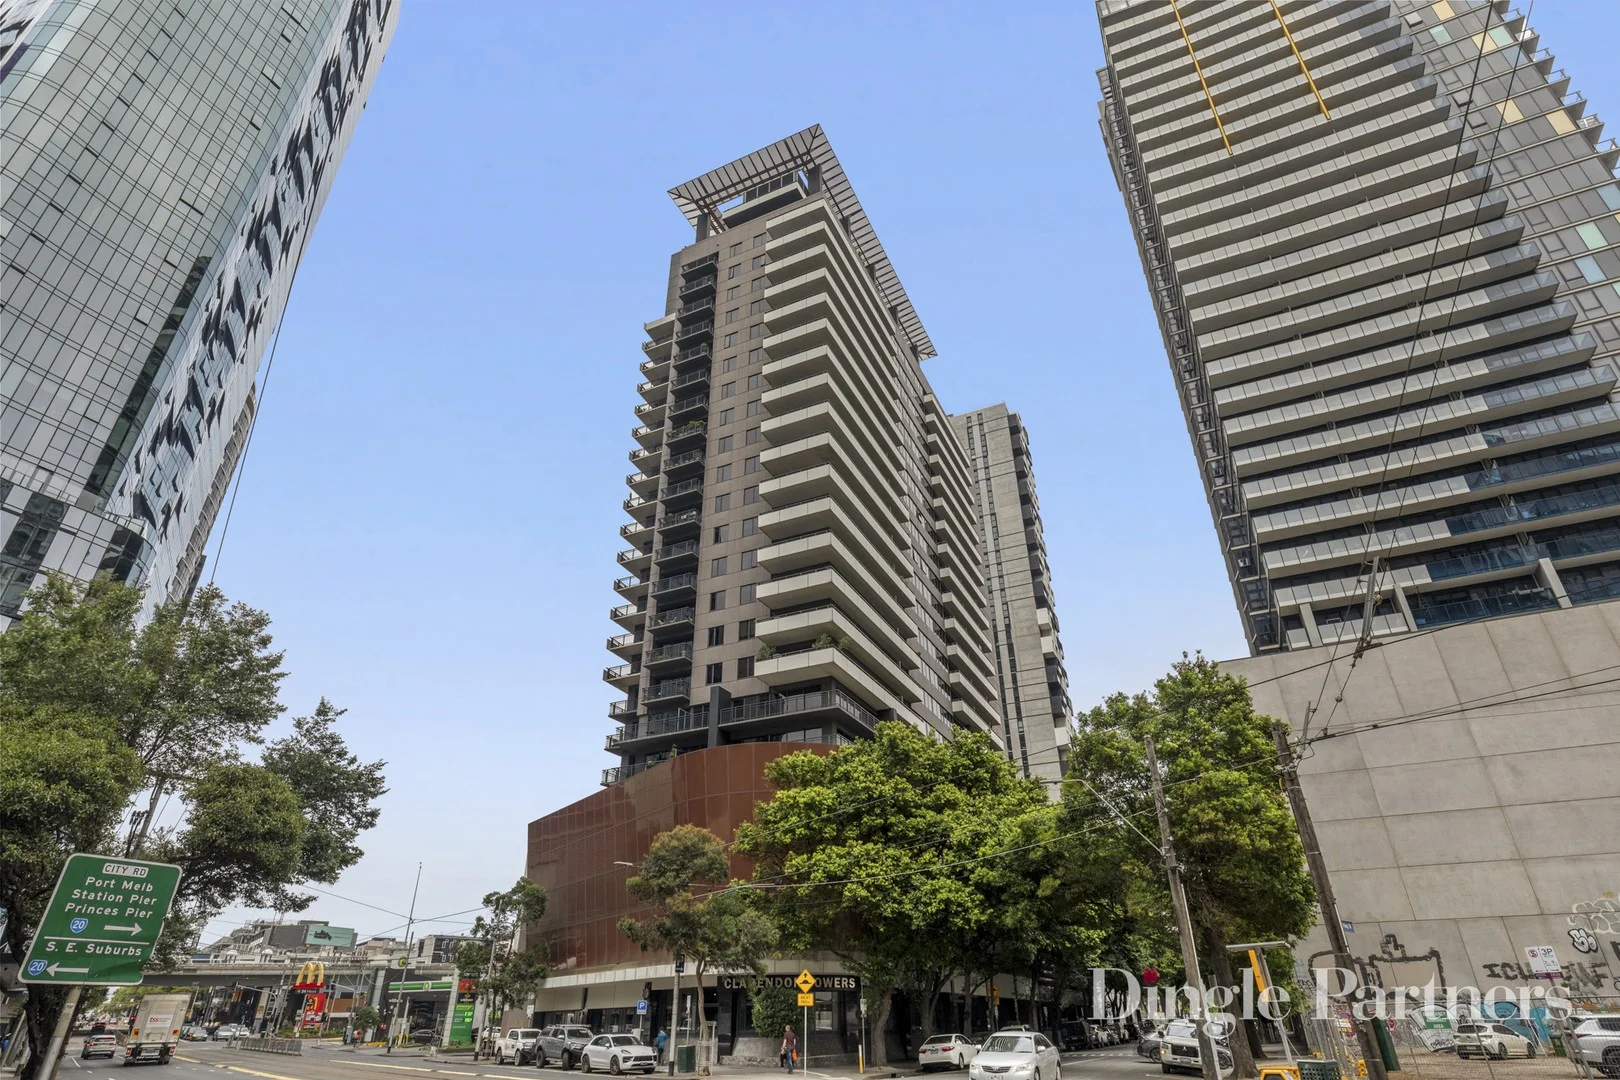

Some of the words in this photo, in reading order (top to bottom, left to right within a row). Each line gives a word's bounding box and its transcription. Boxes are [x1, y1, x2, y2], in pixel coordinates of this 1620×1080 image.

[104, 864, 129, 875] CITY
[132, 867, 147, 877] RD
[85, 876, 116, 889] Port
[121, 880, 154, 892] Melb
[72, 888, 123, 903] Station
[129, 894, 157, 906] Pier
[65, 902, 118, 916] Princes
[125, 907, 153, 919] Pier
[72, 920, 86, 930] 20
[45, 941, 59, 952] S.
[65, 942, 78, 953] E.
[85, 944, 142, 956] Suburbs
[1541, 948, 1553, 956] 3P
[29, 961, 45, 972] 20
[724, 977, 798, 989] CLAENDO
[815, 977, 856, 989] OWERS
